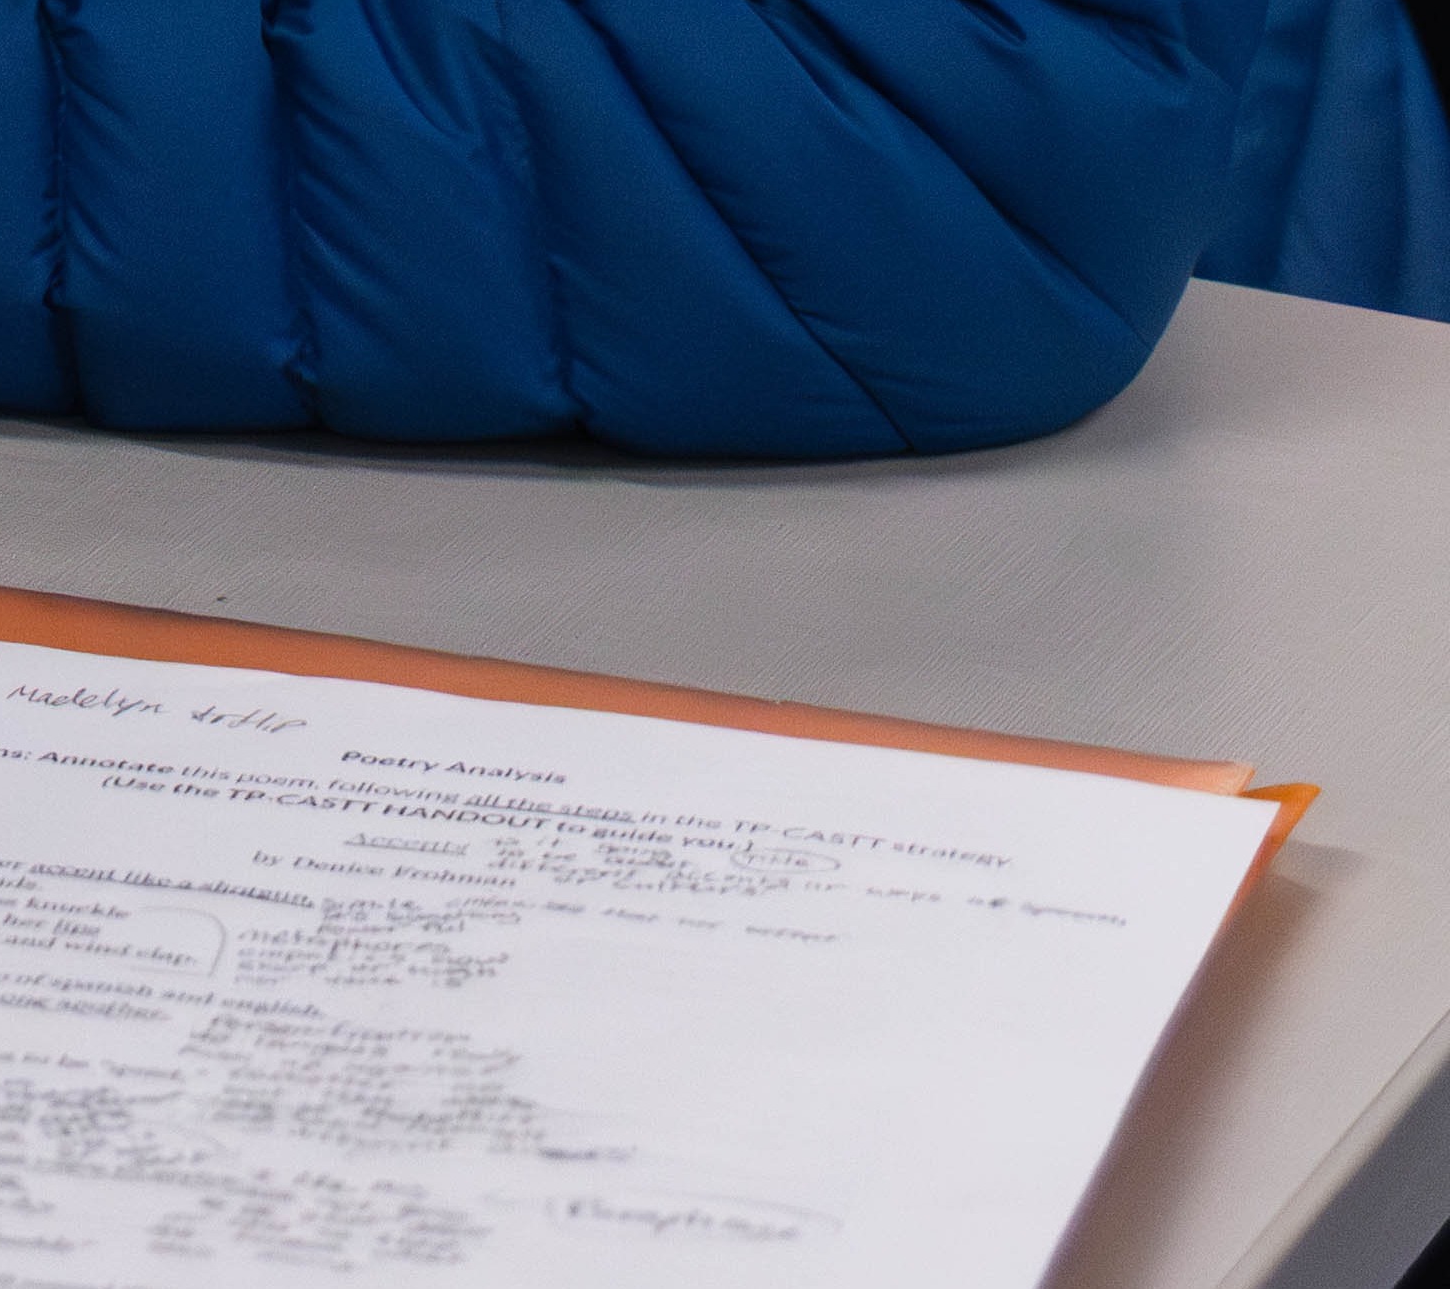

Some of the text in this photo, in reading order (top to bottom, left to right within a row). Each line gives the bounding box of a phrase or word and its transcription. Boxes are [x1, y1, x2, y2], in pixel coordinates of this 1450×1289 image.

[38, 752, 173, 773] Annotate
[328, 779, 459, 804] following
[341, 751, 565, 784] Poetry Analysis
[383, 804, 548, 828] HANDOUT
